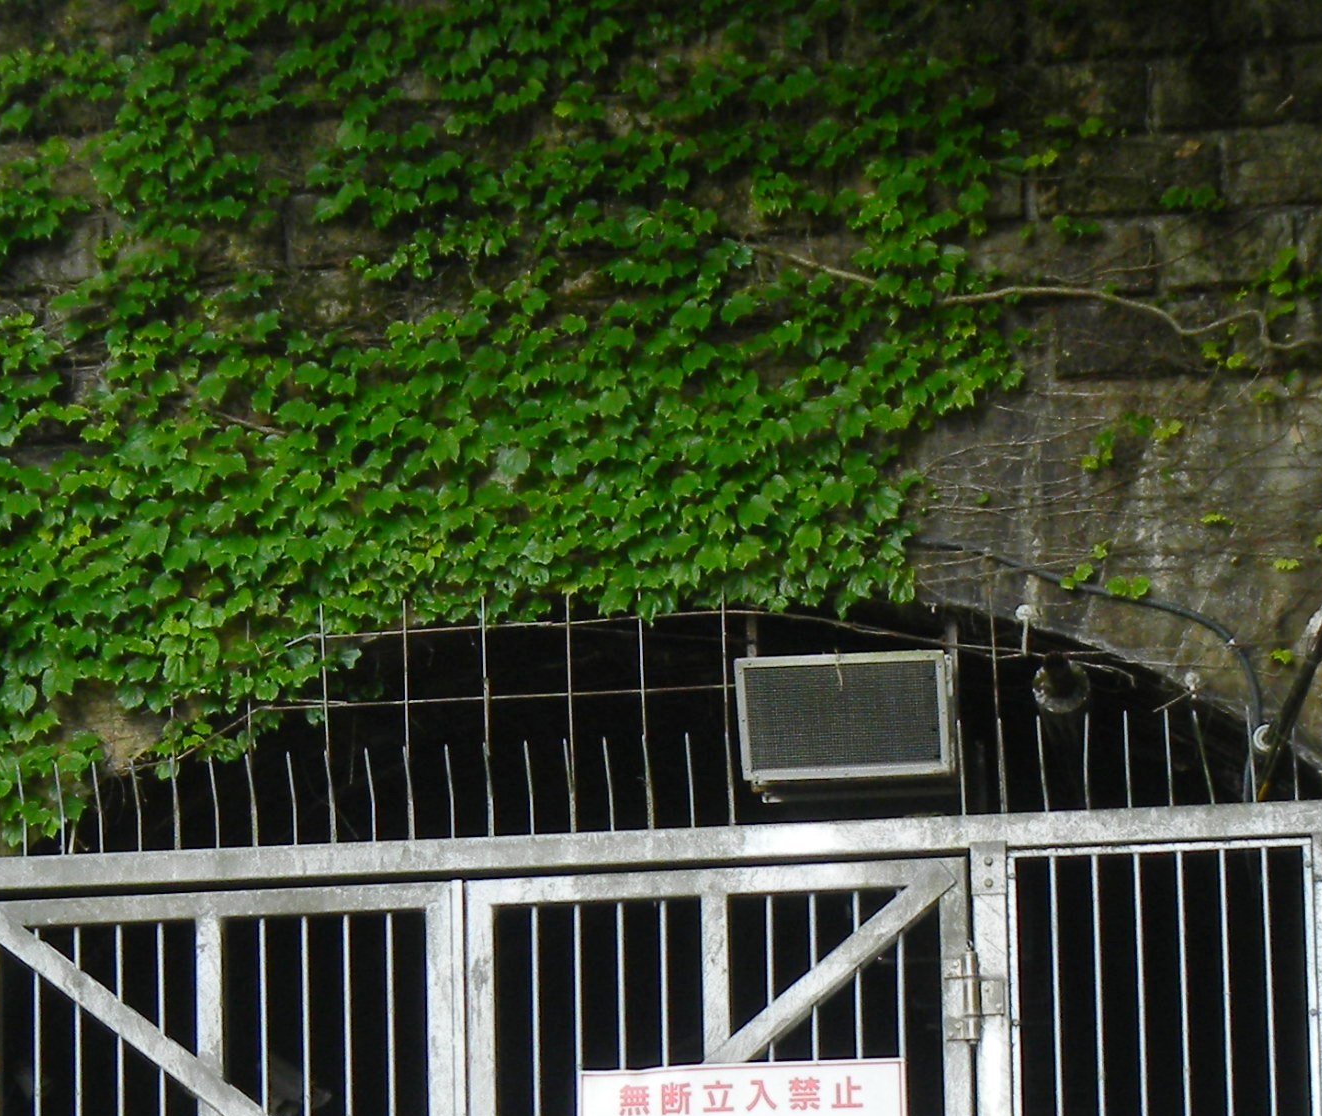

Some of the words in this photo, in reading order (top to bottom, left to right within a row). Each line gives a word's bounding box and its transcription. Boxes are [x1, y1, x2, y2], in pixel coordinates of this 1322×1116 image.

[618, 1075, 864, 1116] 無断立入禁止
